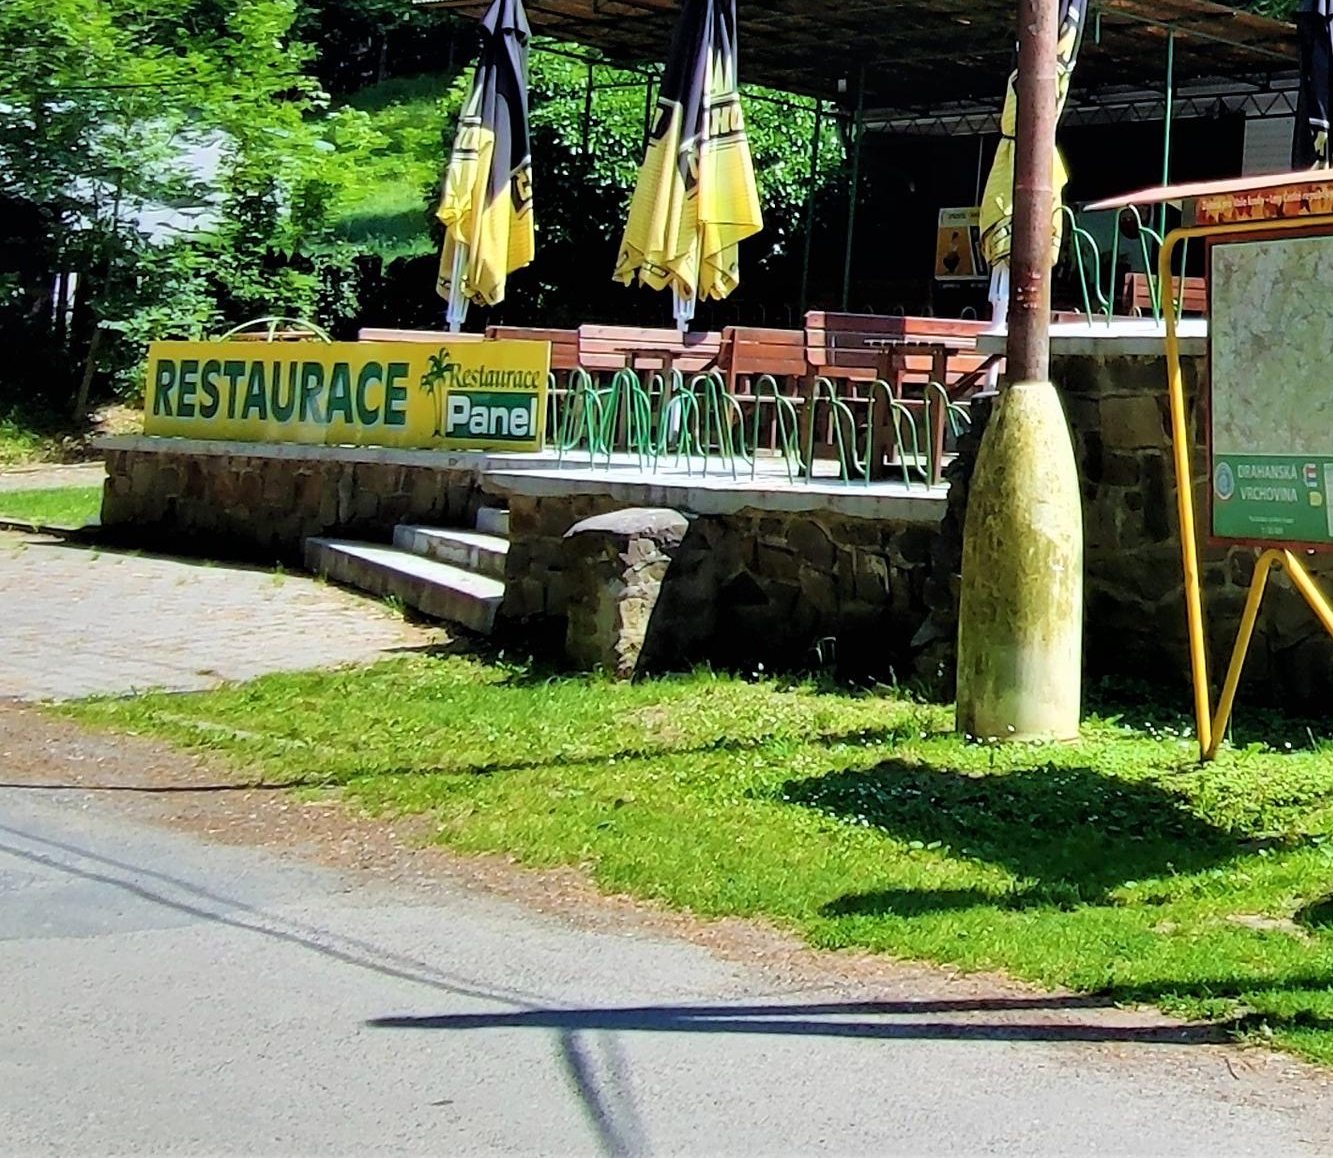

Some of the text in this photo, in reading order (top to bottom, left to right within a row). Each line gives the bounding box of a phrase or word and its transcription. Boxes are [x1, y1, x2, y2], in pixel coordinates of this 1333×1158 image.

[449, 363, 540, 388] Restaurace
[153, 358, 410, 427] RESTAURACE
[446, 394, 538, 437] Panel
[1237, 463, 1298, 479] DRAHANSKÁ
[1240, 487, 1298, 502] VRCHOVINA
